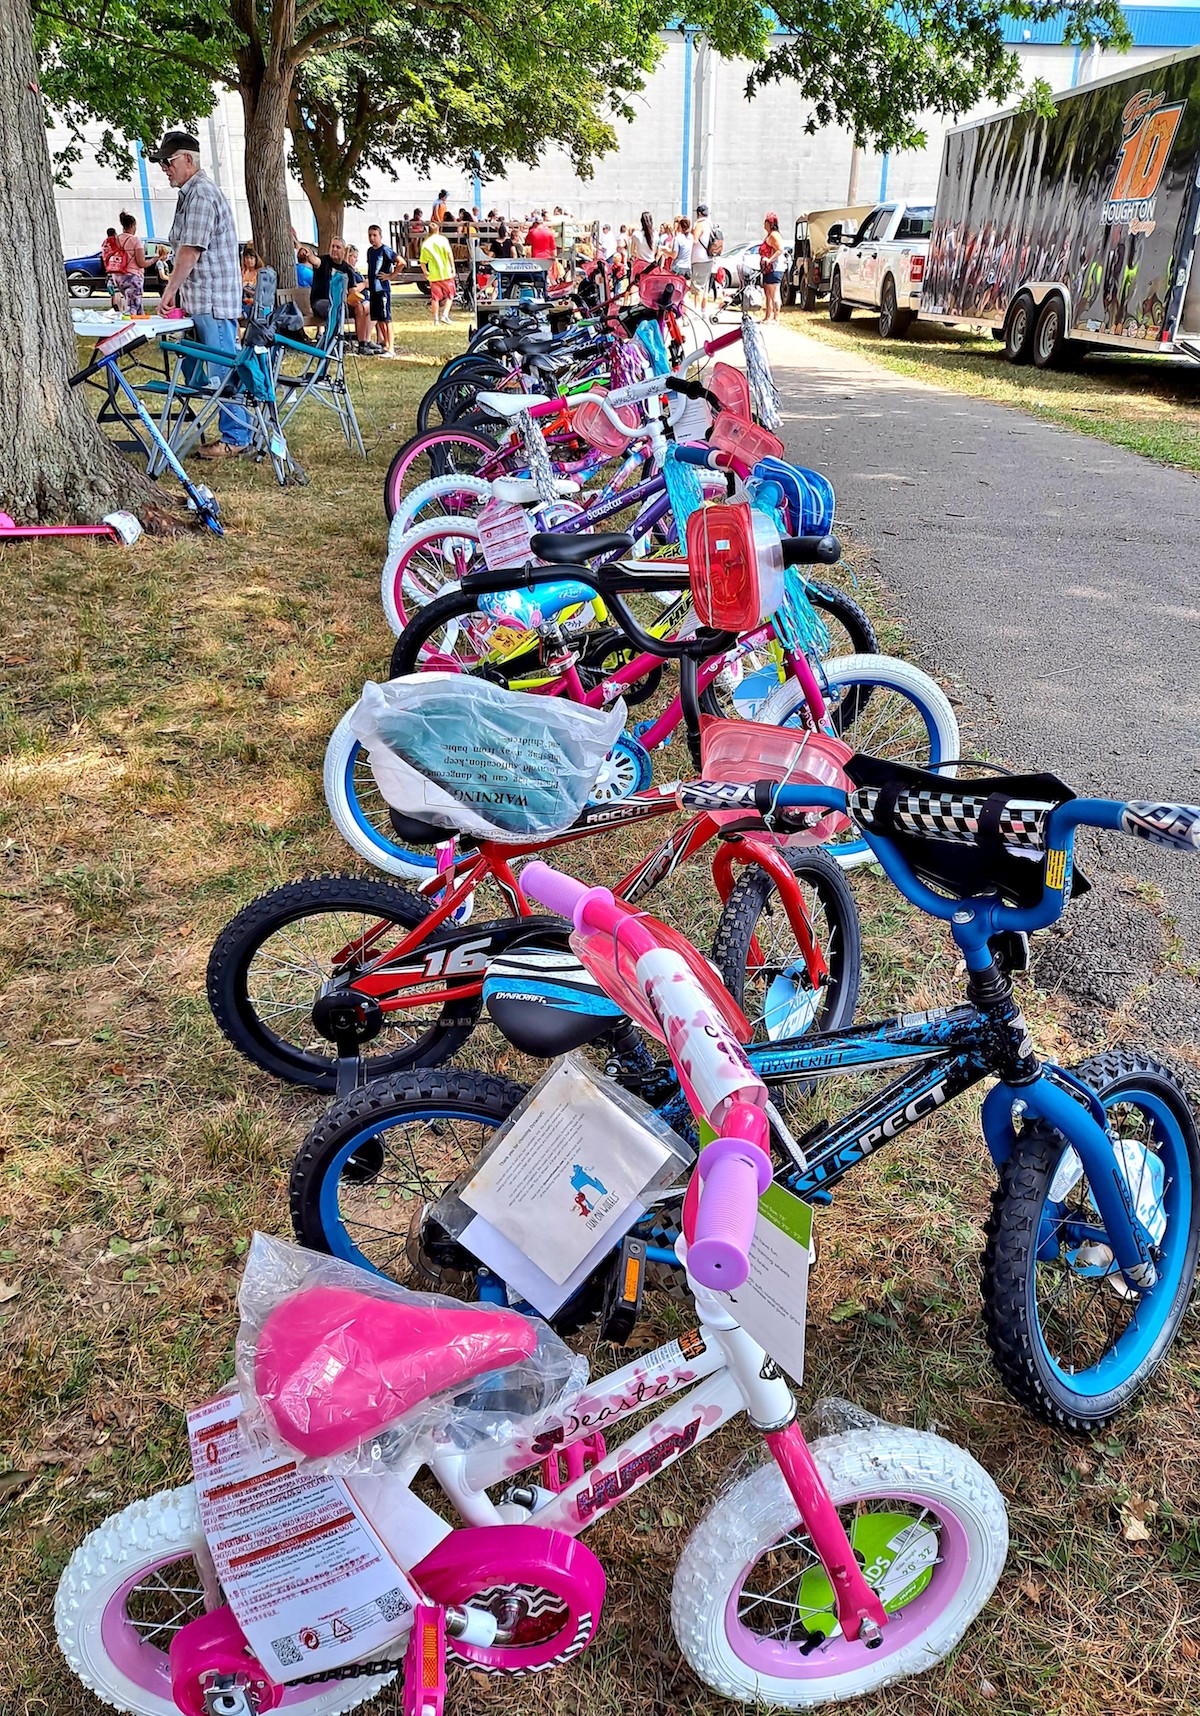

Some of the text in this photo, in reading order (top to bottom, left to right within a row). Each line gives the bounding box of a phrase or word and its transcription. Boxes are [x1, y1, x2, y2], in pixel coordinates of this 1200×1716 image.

[1110, 102, 1184, 201] 10
[1101, 199, 1157, 222] HOUGHTON
[454, 789, 528, 806] WARNING
[587, 808, 633, 824] ROCK
[422, 937, 494, 977] 16
[495, 992, 546, 1004] DYNACRAFT
[760, 1052, 843, 1073] DYNACRAFT
[795, 1079, 948, 1191] SUSPECT
[584, 1216, 599, 1231] FUN
[592, 1209, 605, 1221] ON
[576, 1416, 702, 1522] HUFFY
[864, 1556, 891, 1588] IDS
